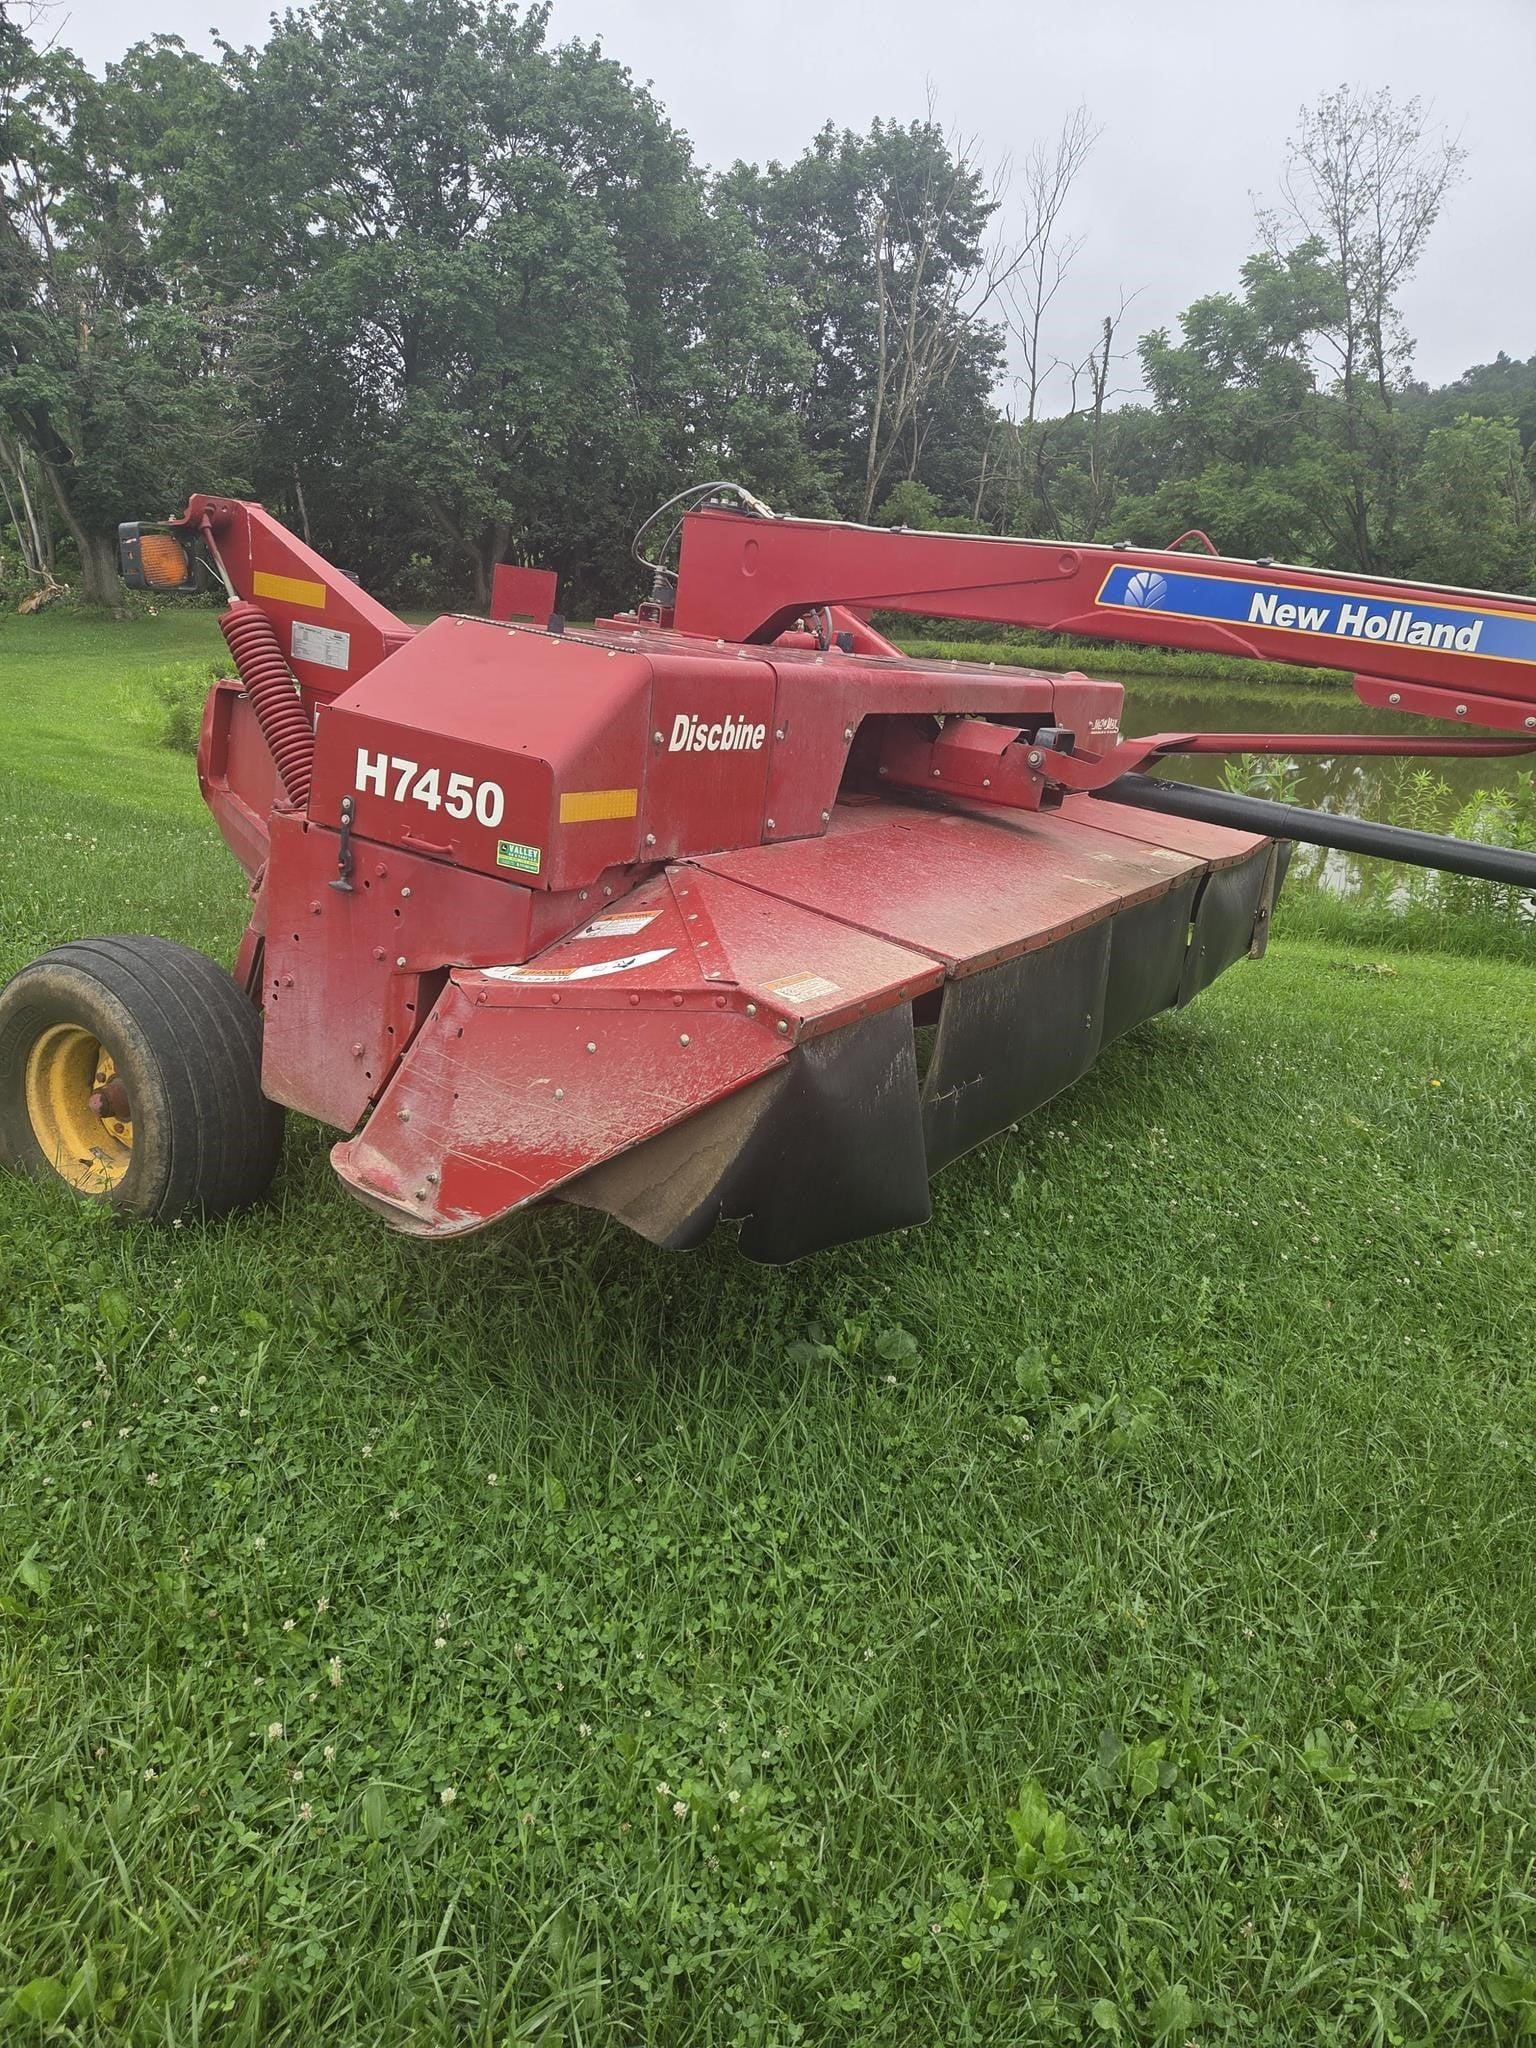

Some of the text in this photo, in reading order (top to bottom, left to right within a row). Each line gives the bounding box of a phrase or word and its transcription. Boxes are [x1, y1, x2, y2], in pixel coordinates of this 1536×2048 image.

[1248, 592, 1483, 652] New Holland
[668, 714, 766, 752] Discbine
[355, 748, 505, 828] H7450
[509, 844, 538, 858] VALLEY
